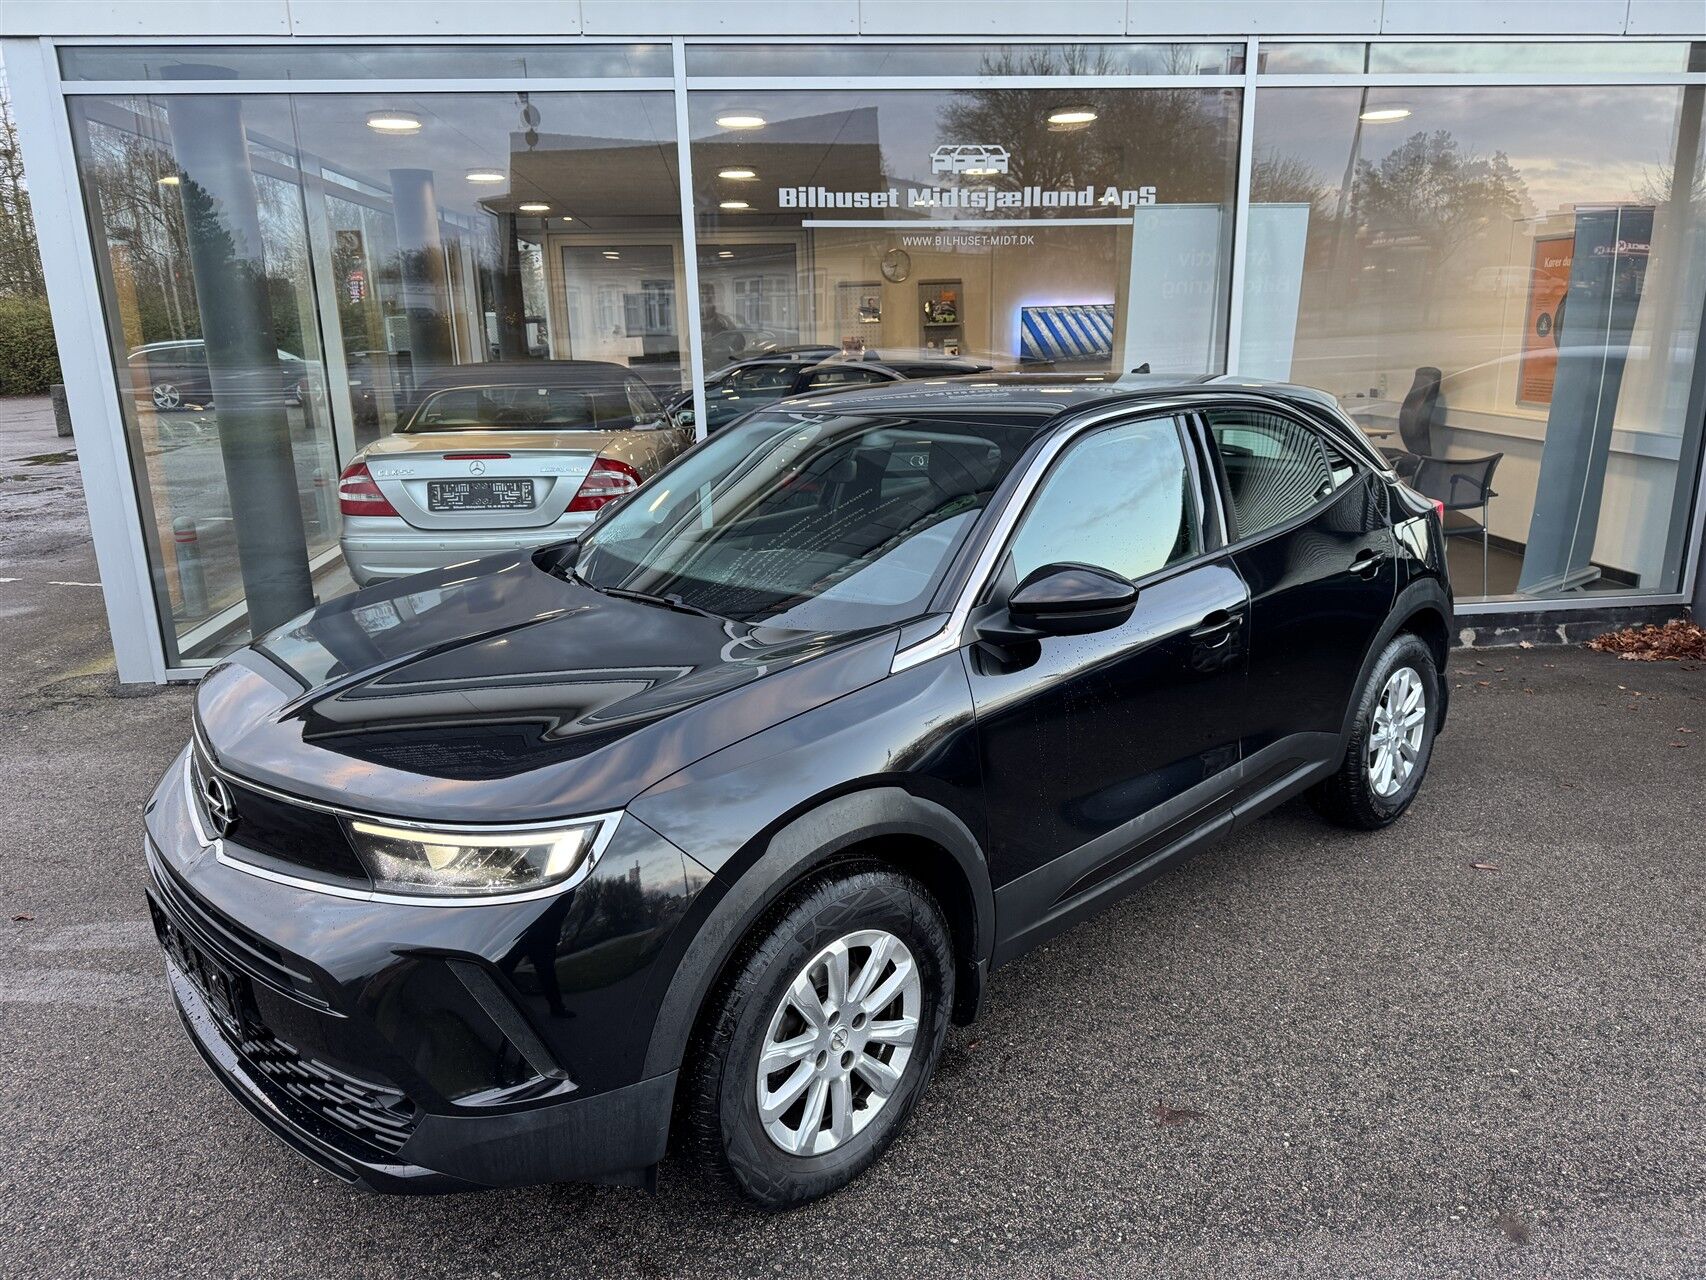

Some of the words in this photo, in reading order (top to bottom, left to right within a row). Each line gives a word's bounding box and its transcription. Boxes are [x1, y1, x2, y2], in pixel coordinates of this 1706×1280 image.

[778, 186, 899, 208] Bilhuset
[907, 186, 1095, 212] Midtsjælland
[1100, 186, 1157, 210] ApS
[902, 235, 1035, 246] WWW.BILHUSET-MIDT.DK
